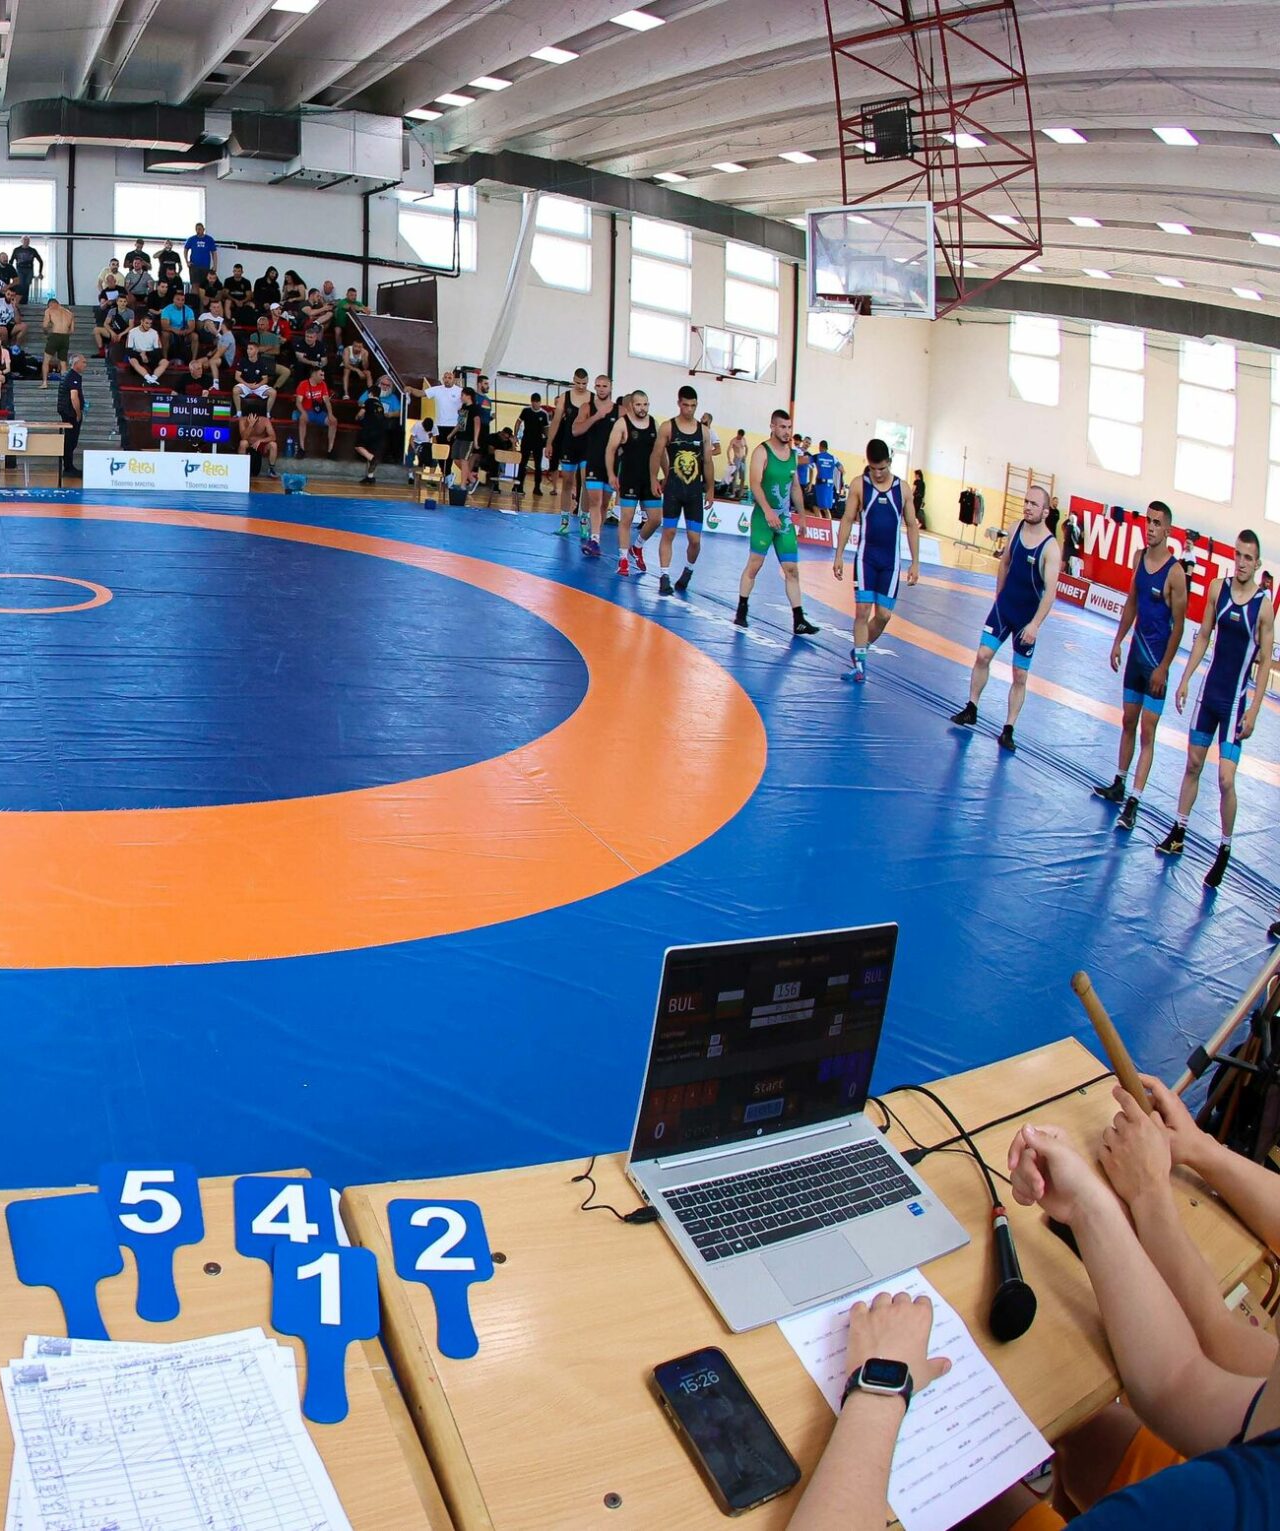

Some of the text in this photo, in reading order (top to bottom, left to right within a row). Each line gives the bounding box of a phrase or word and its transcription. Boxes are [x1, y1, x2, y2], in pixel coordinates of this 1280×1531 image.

[173, 406, 190, 415] BUL
[193, 407, 210, 416] BUL
[160, 426, 167, 437] 0
[177, 427, 204, 438] 6:00
[213, 429, 221, 440] 0
[128, 458, 155, 475] Petrol
[202, 459, 229, 477] Petrol
[864, 969, 884, 985] BUL
[777, 983, 799, 999] 156
[668, 996, 696, 1013] BUL
[848, 1082, 856, 1097] 0
[654, 1121, 665, 1139] 0
[118, 1169, 182, 1235] 5
[251, 1184, 319, 1244] 4
[410, 1206, 476, 1271] 2
[296, 1252, 341, 1326] 1
[679, 1370, 720, 1395] 15:26
